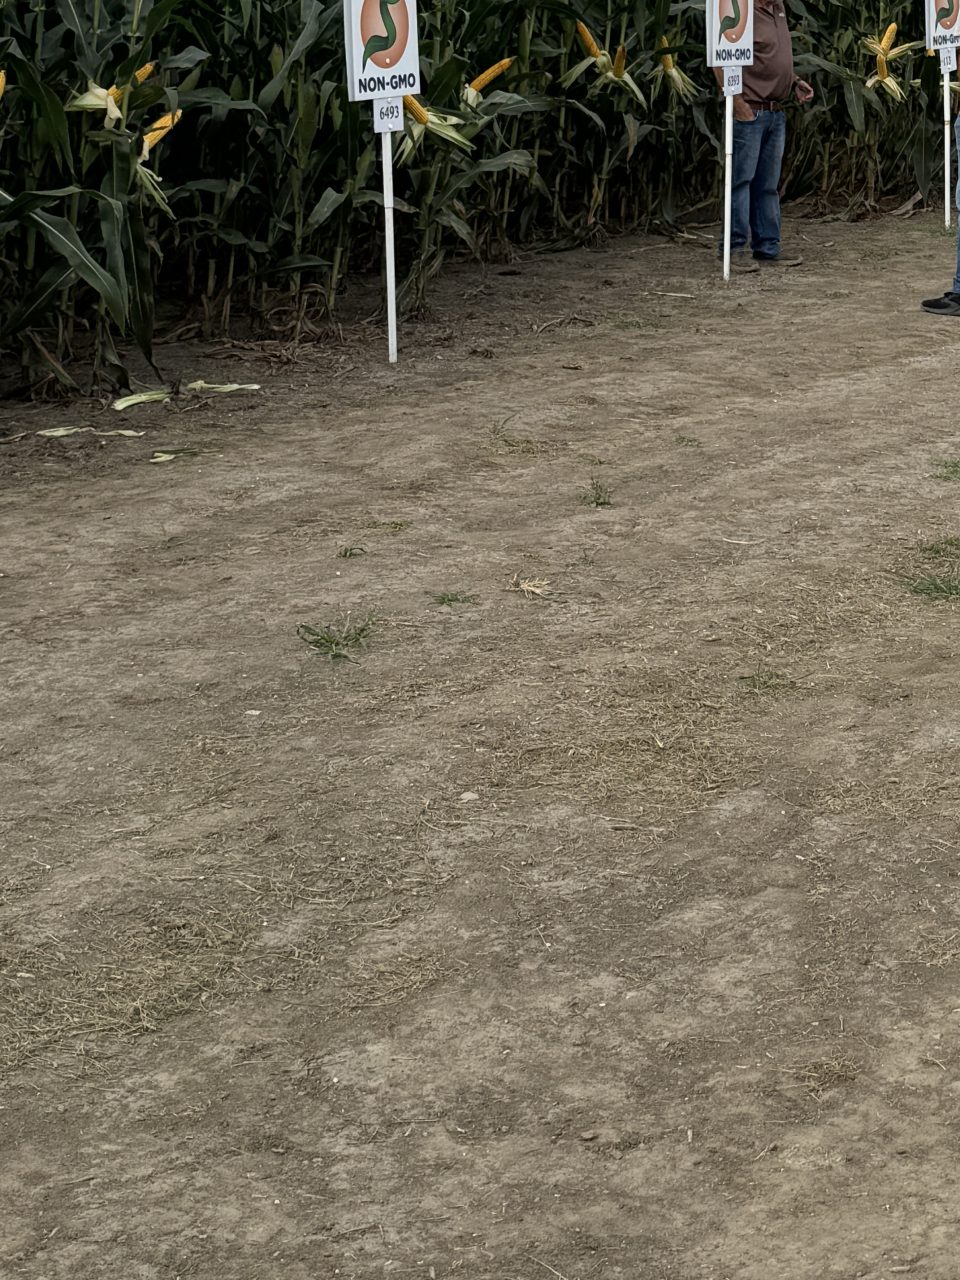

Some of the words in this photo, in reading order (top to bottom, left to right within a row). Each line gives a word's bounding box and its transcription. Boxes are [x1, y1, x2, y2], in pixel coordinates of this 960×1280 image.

[716, 47, 752, 62] NON-GMO
[358, 72, 416, 94] NON-GMO
[379, 104, 400, 121] 6493
